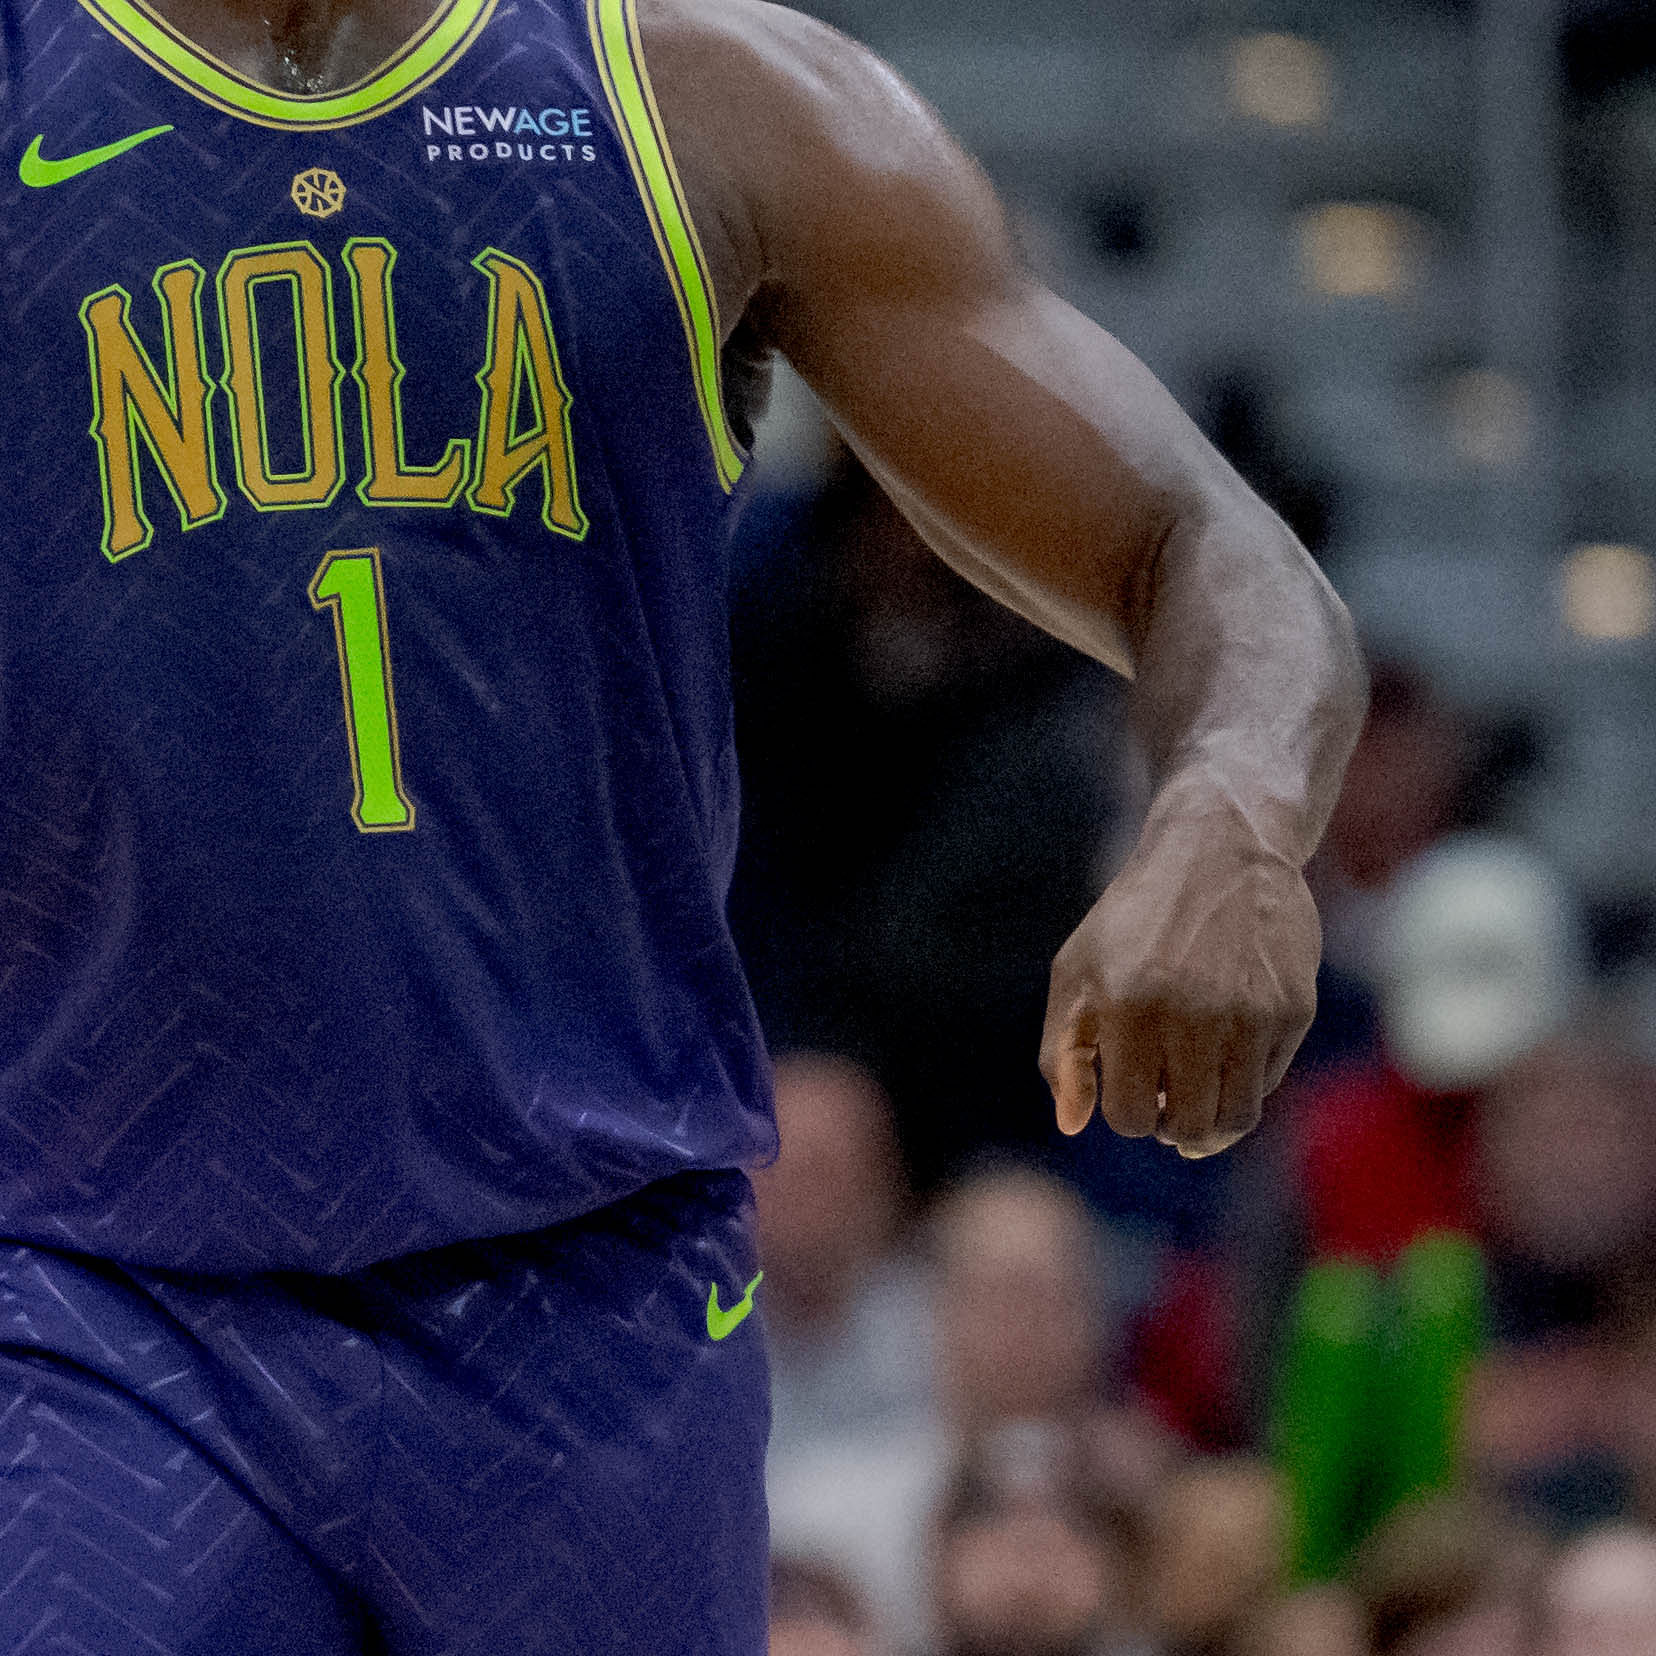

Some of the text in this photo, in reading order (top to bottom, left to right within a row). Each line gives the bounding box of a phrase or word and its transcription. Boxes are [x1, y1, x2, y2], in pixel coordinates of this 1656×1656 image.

[422, 105, 593, 137] NEWAGE
[427, 142, 597, 162] PRODUCTS
[79, 237, 589, 562] NOLA
[308, 547, 415, 833] 1
